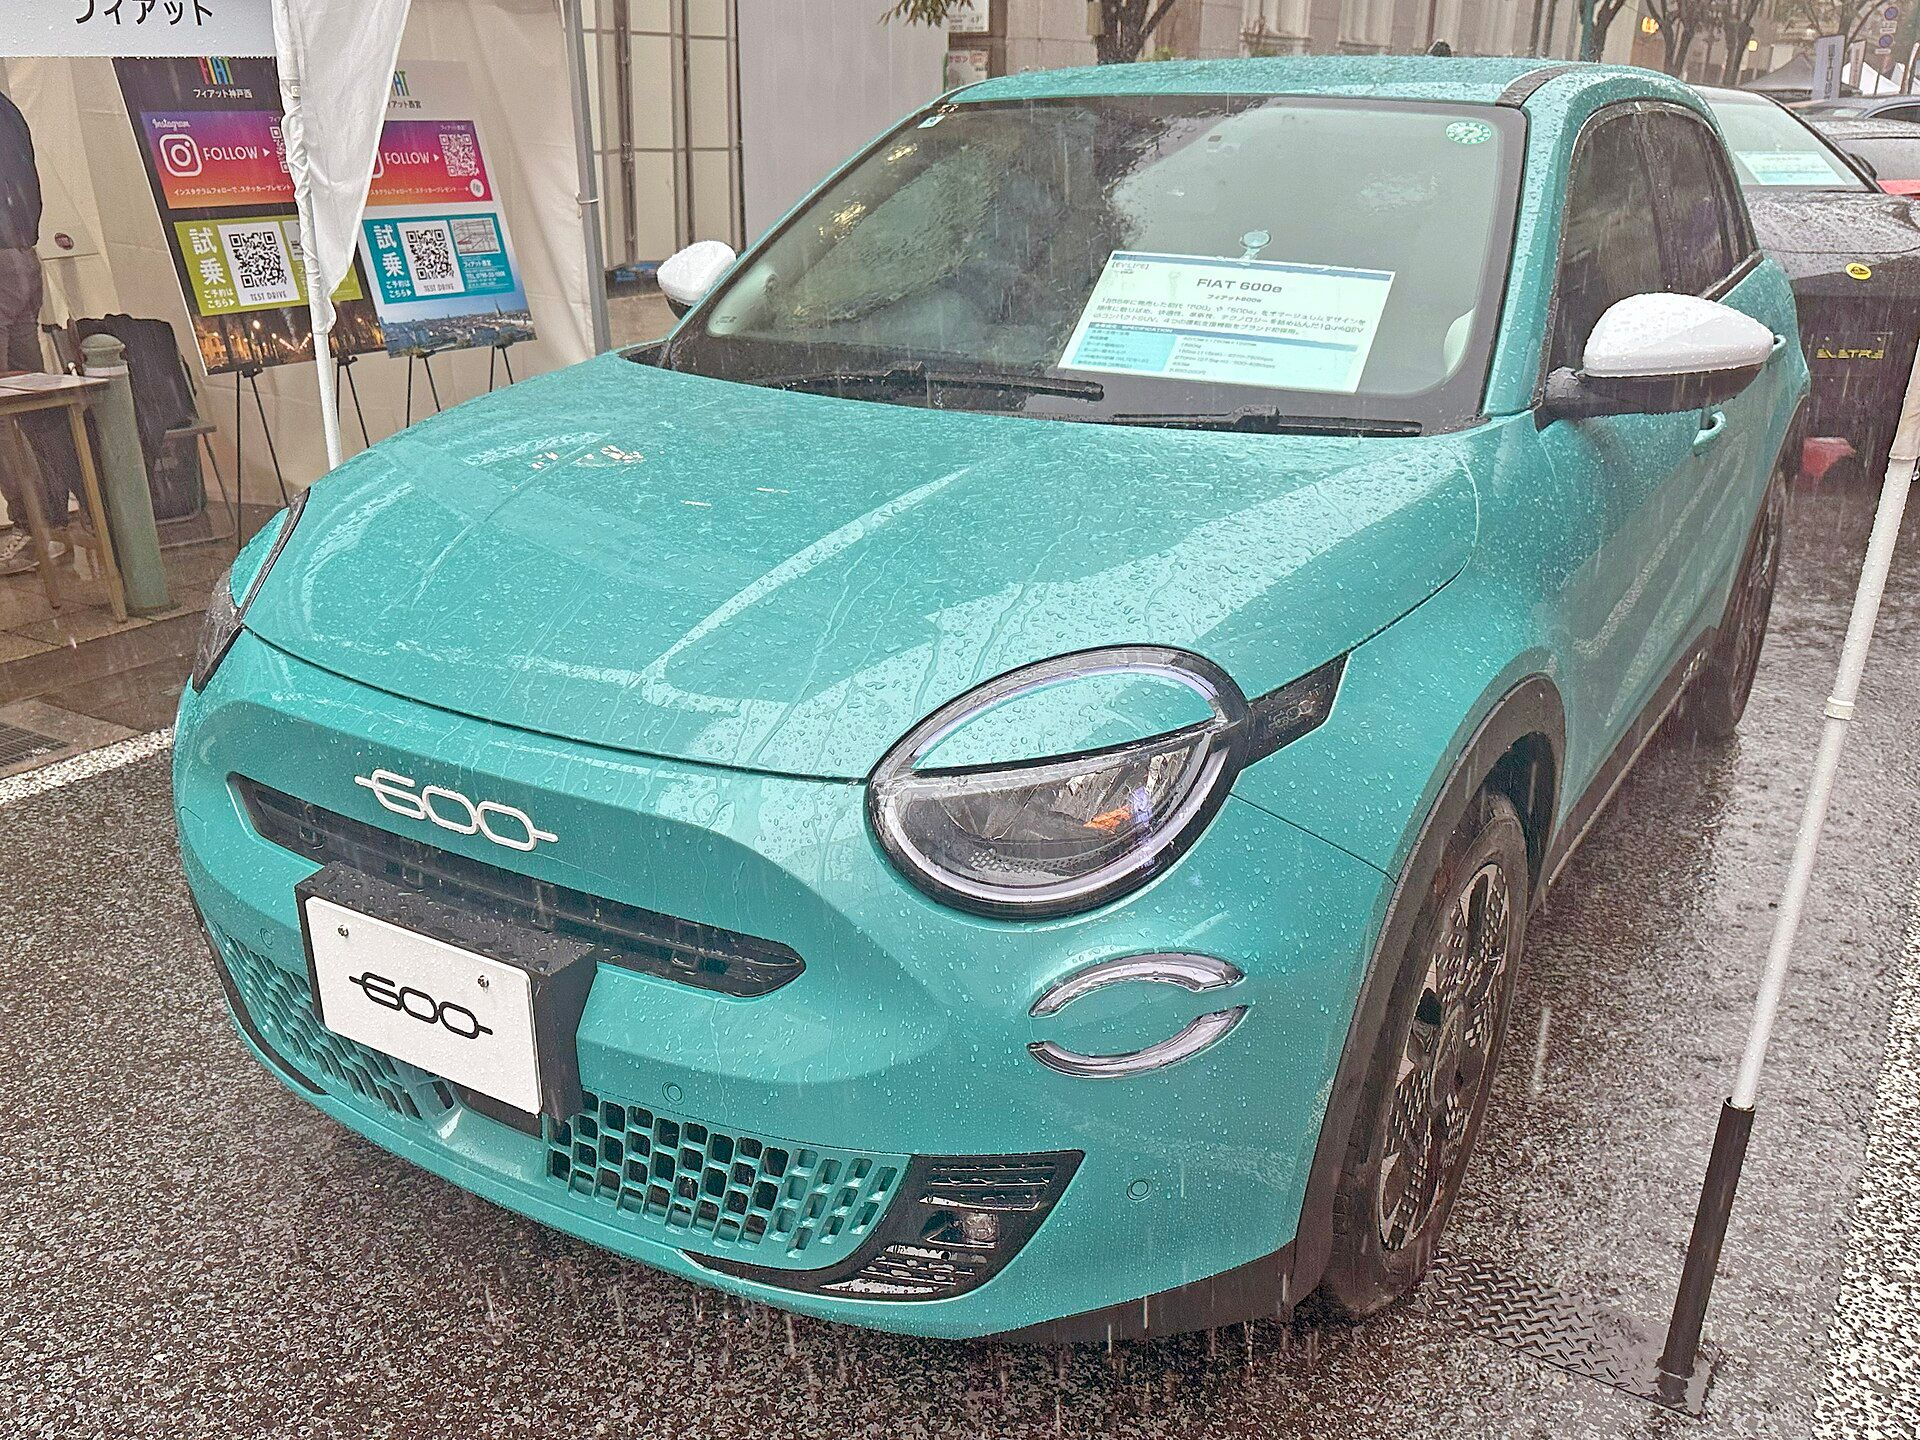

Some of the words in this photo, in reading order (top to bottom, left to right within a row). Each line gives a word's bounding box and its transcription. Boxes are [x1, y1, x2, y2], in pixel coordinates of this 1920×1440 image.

[75, 0, 214, 26] フィアット
[392, 70, 411, 97] AT
[192, 88, 254, 100] フィアット神戸西
[152, 118, 191, 131] Instagram
[202, 146, 259, 161] FOLLOW
[384, 151, 430, 165] FOLLOW
[423, 284, 437, 293] TEST
[437, 282, 455, 292] DRIVE
[1196, 278, 1237, 290] FIAT
[1239, 281, 1283, 294] 600e
[203, 288, 234, 299] ご予約は
[249, 292, 266, 302] TEST
[266, 290, 288, 301] DRIVE
[388, 290, 408, 299] こちら
[207, 299, 230, 309] こちら
[354, 768, 559, 852] 600
[348, 971, 494, 1040] 600
